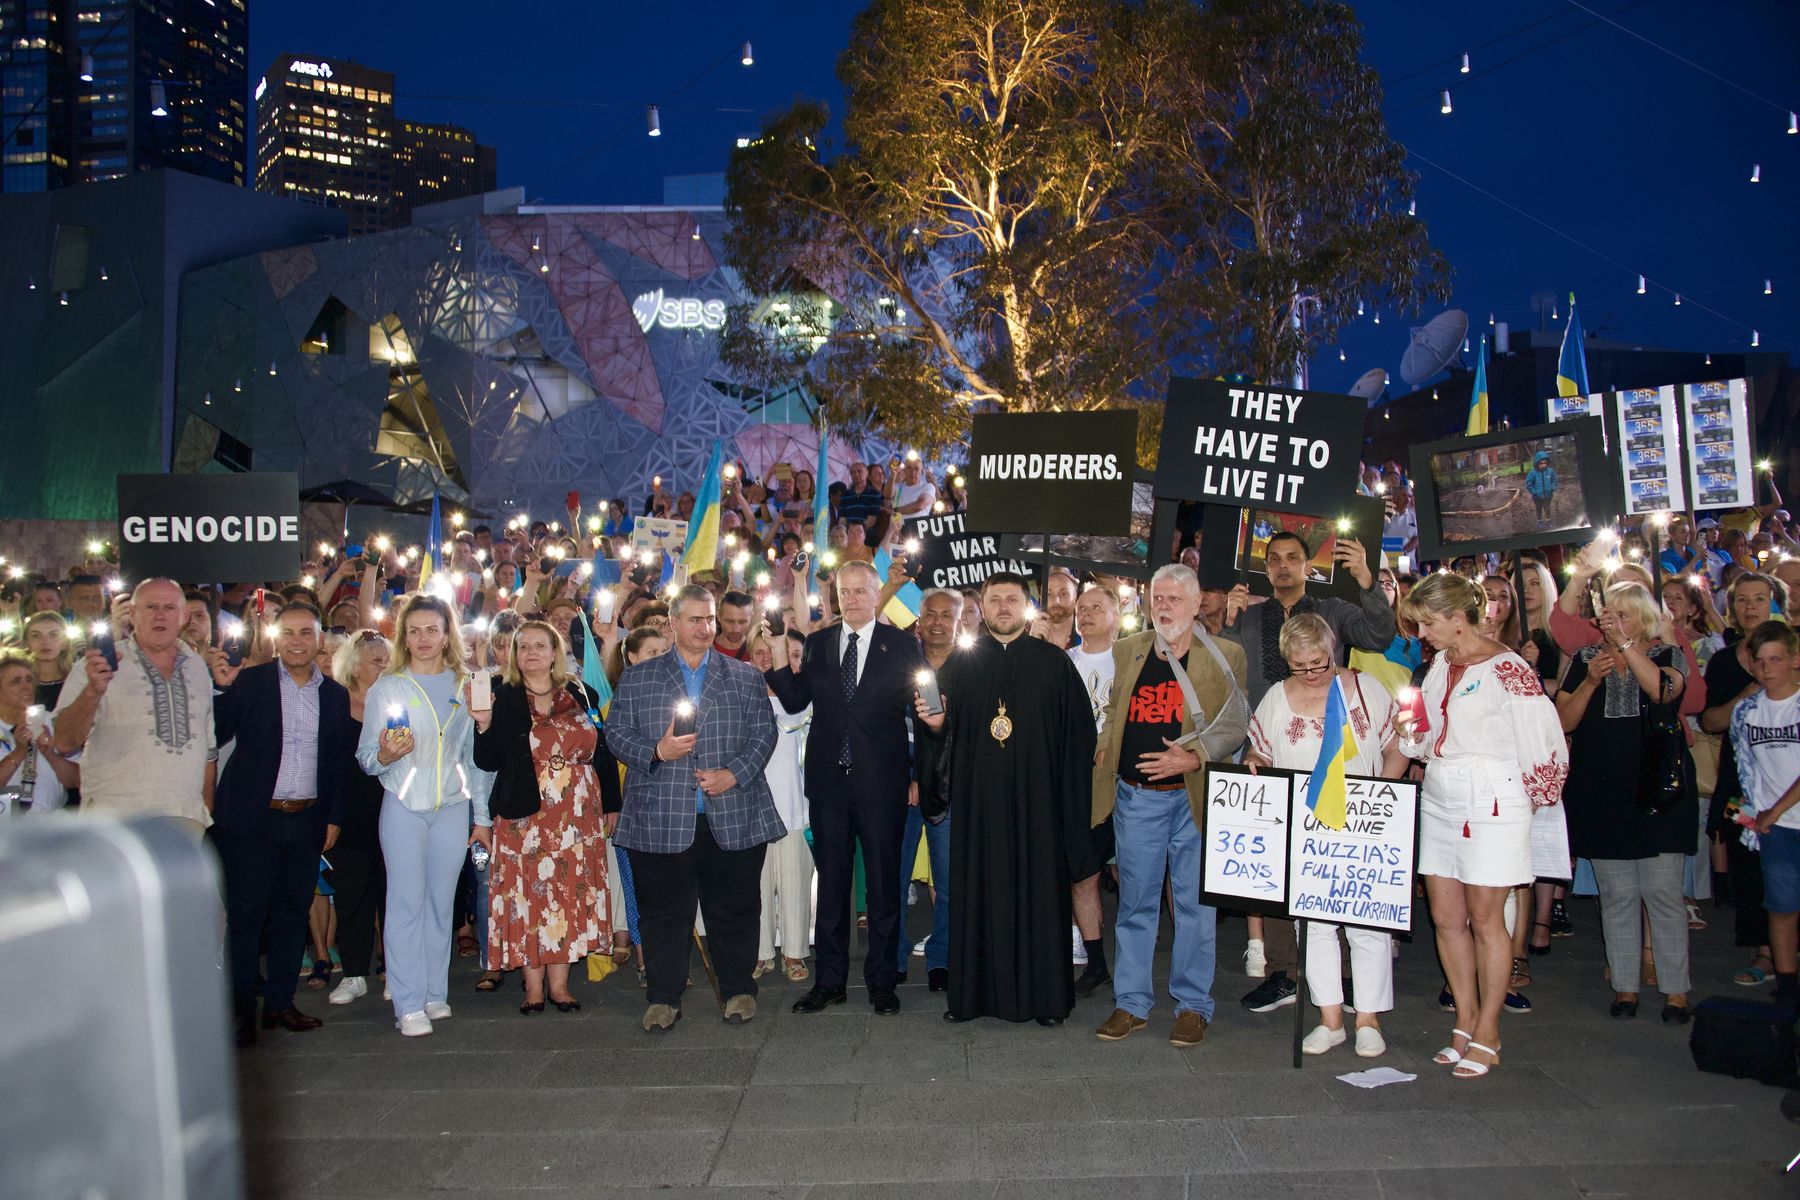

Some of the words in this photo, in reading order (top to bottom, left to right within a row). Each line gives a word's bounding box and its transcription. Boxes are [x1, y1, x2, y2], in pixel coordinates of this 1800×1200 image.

[405, 123, 472, 144] SOFITEL
[659, 298, 726, 328] SBS
[1632, 389, 1652, 403] 365
[1700, 383, 1721, 397] 365
[1228, 388, 1303, 424] THEY
[1562, 397, 1582, 411] 365
[1634, 419, 1654, 433] 365
[1194, 426, 1279, 463] HAVE
[1289, 438, 1330, 469] TO
[1637, 449, 1657, 463] 365
[979, 453, 1123, 481] MURDERERS.
[1203, 465, 1267, 500] LIVE
[1275, 474, 1305, 504] IT
[1640, 480, 1660, 494] 365
[123, 515, 299, 543] GENOCIDE
[917, 512, 967, 539] PUTI
[950, 536, 998, 560] WAR
[933, 558, 1033, 588] CRIMINAL
[1213, 779, 1272, 816] 2014
[1215, 831, 1266, 855] 365
[1302, 838, 1401, 866] RUZZIA'S
[1222, 859, 1273, 880] DAYS
[1301, 861, 1340, 880] FULL
[1345, 865, 1407, 887] SCALE
[1328, 879, 1373, 901] WAR
[1295, 892, 1352, 915] AGAINST
[1352, 900, 1410, 924] UKRAINE
